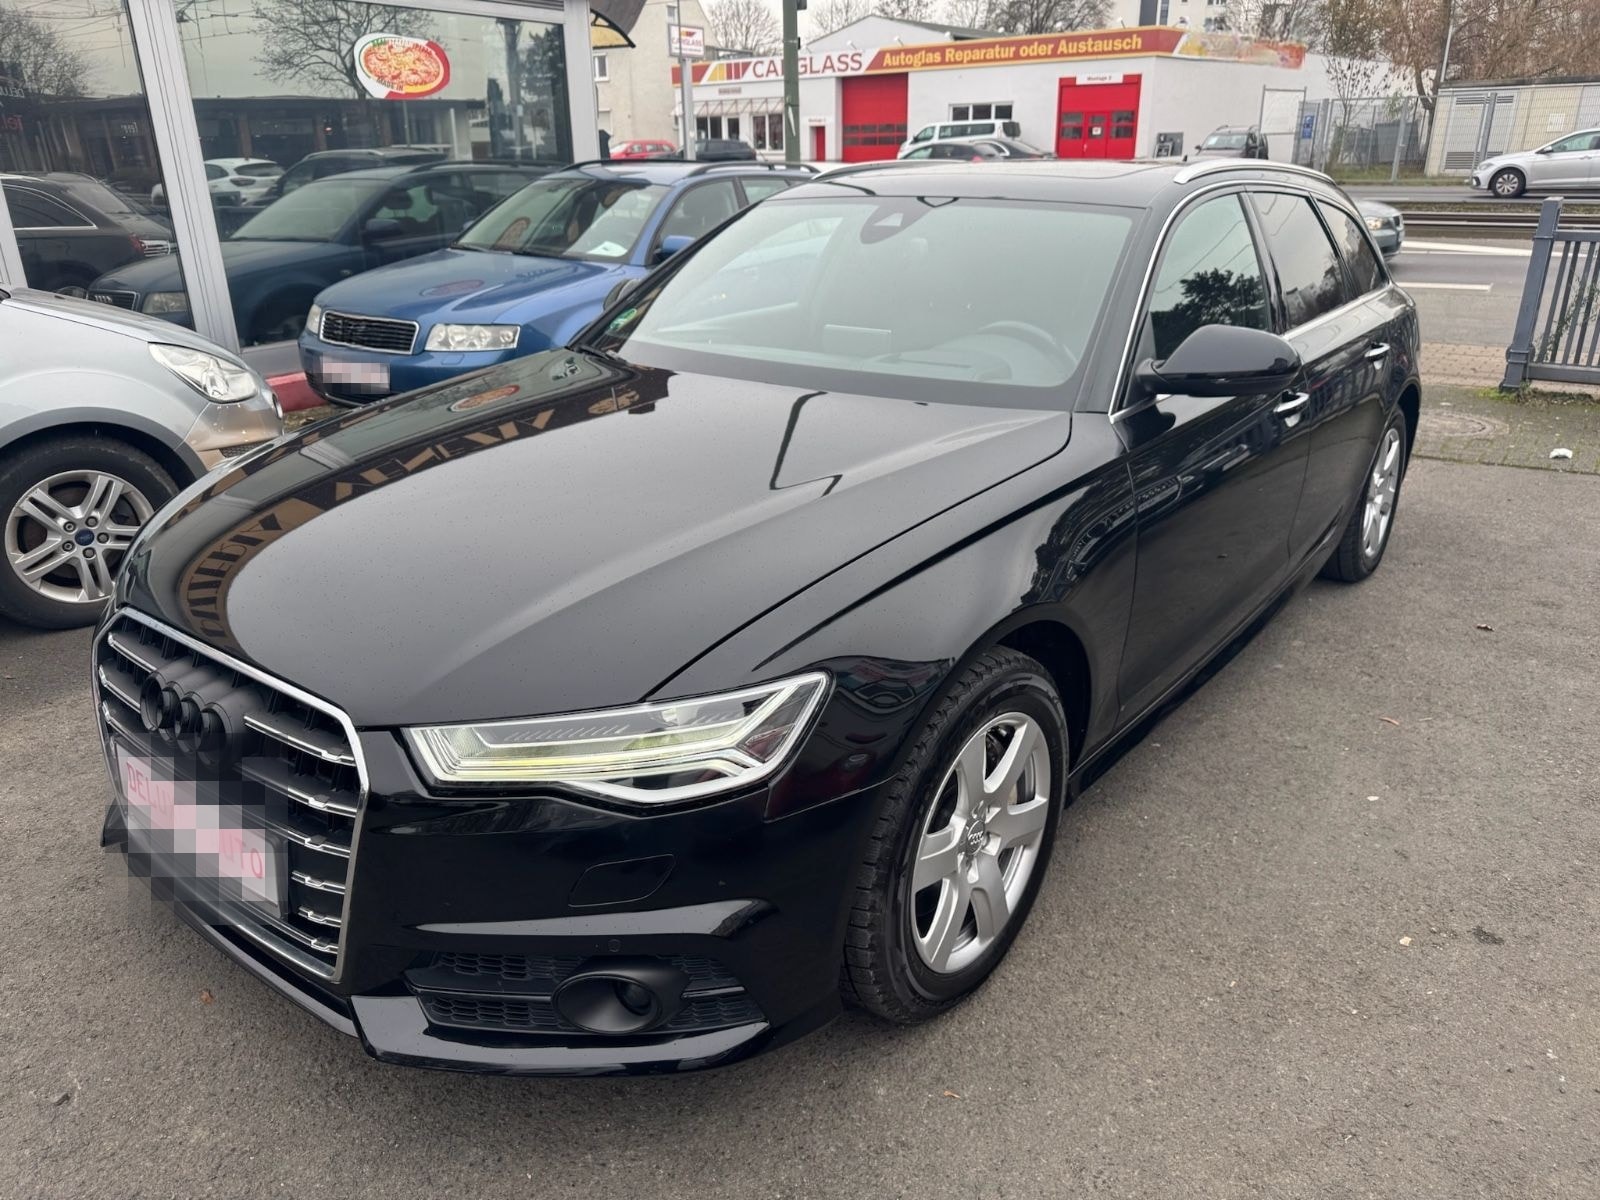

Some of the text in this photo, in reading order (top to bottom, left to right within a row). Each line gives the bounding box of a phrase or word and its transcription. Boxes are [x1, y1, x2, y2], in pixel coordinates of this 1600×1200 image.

[752, 52, 863, 78] CAGLASS
[882, 34, 1142, 68] Autoglas Reparatur oder Austausch
